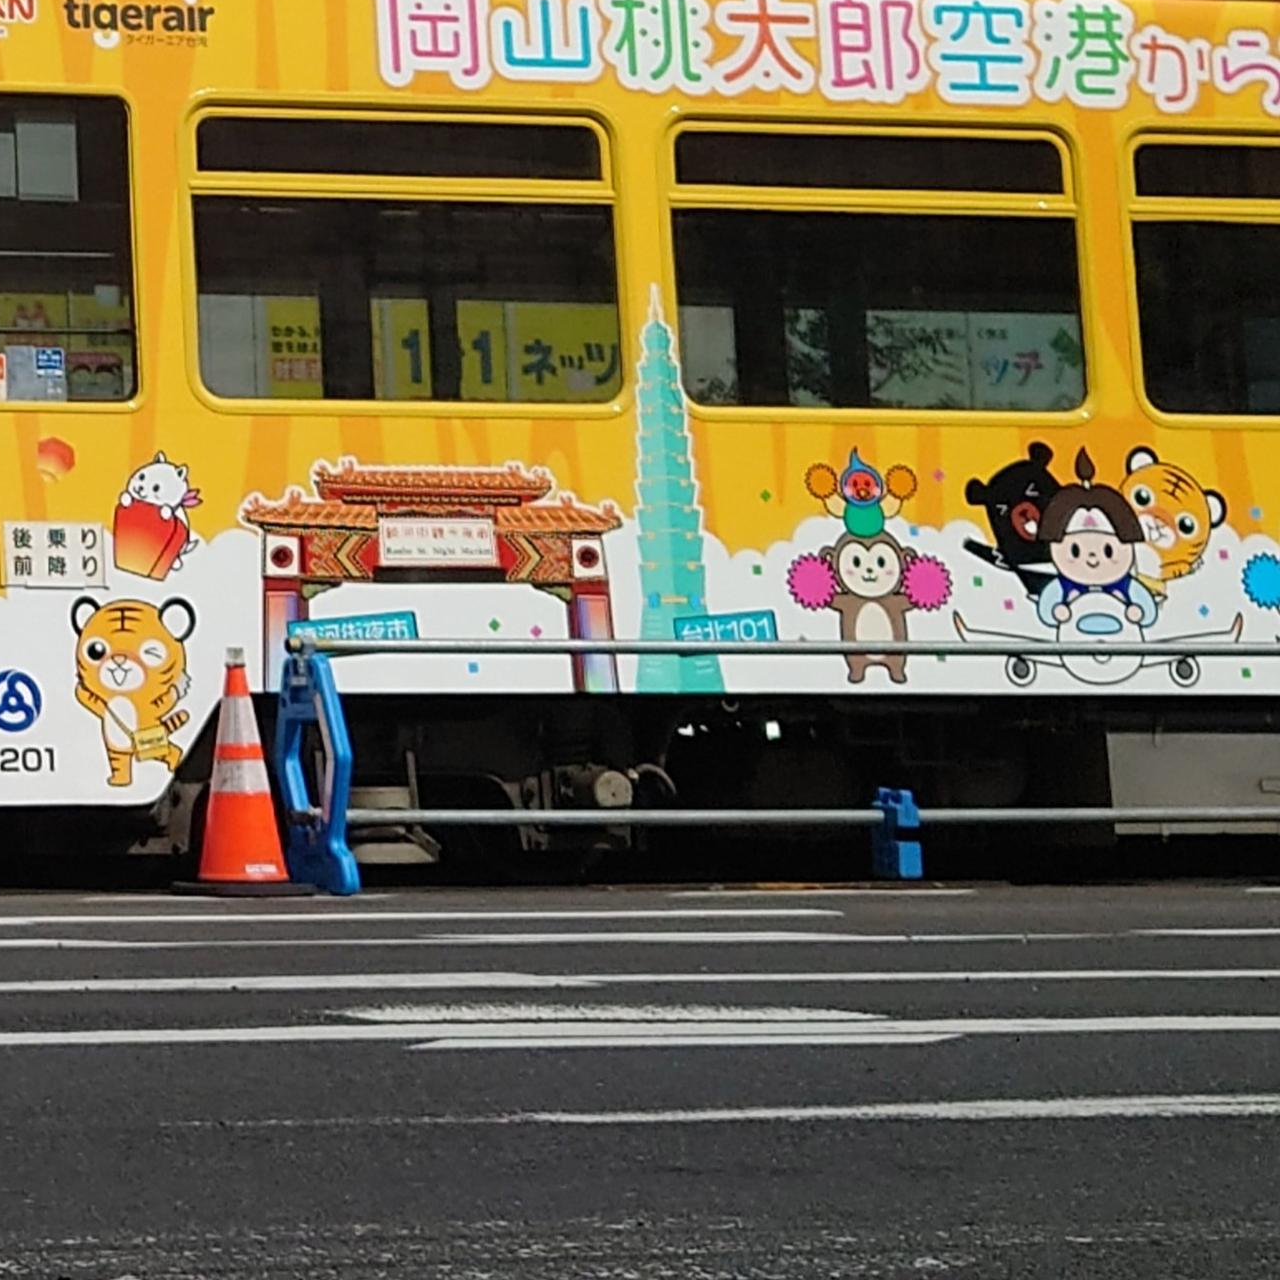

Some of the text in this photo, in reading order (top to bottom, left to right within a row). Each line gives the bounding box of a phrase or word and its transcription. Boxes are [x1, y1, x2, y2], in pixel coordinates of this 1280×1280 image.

[12, 527, 97, 550] 後乗り
[13, 555, 98, 577] 前降り
